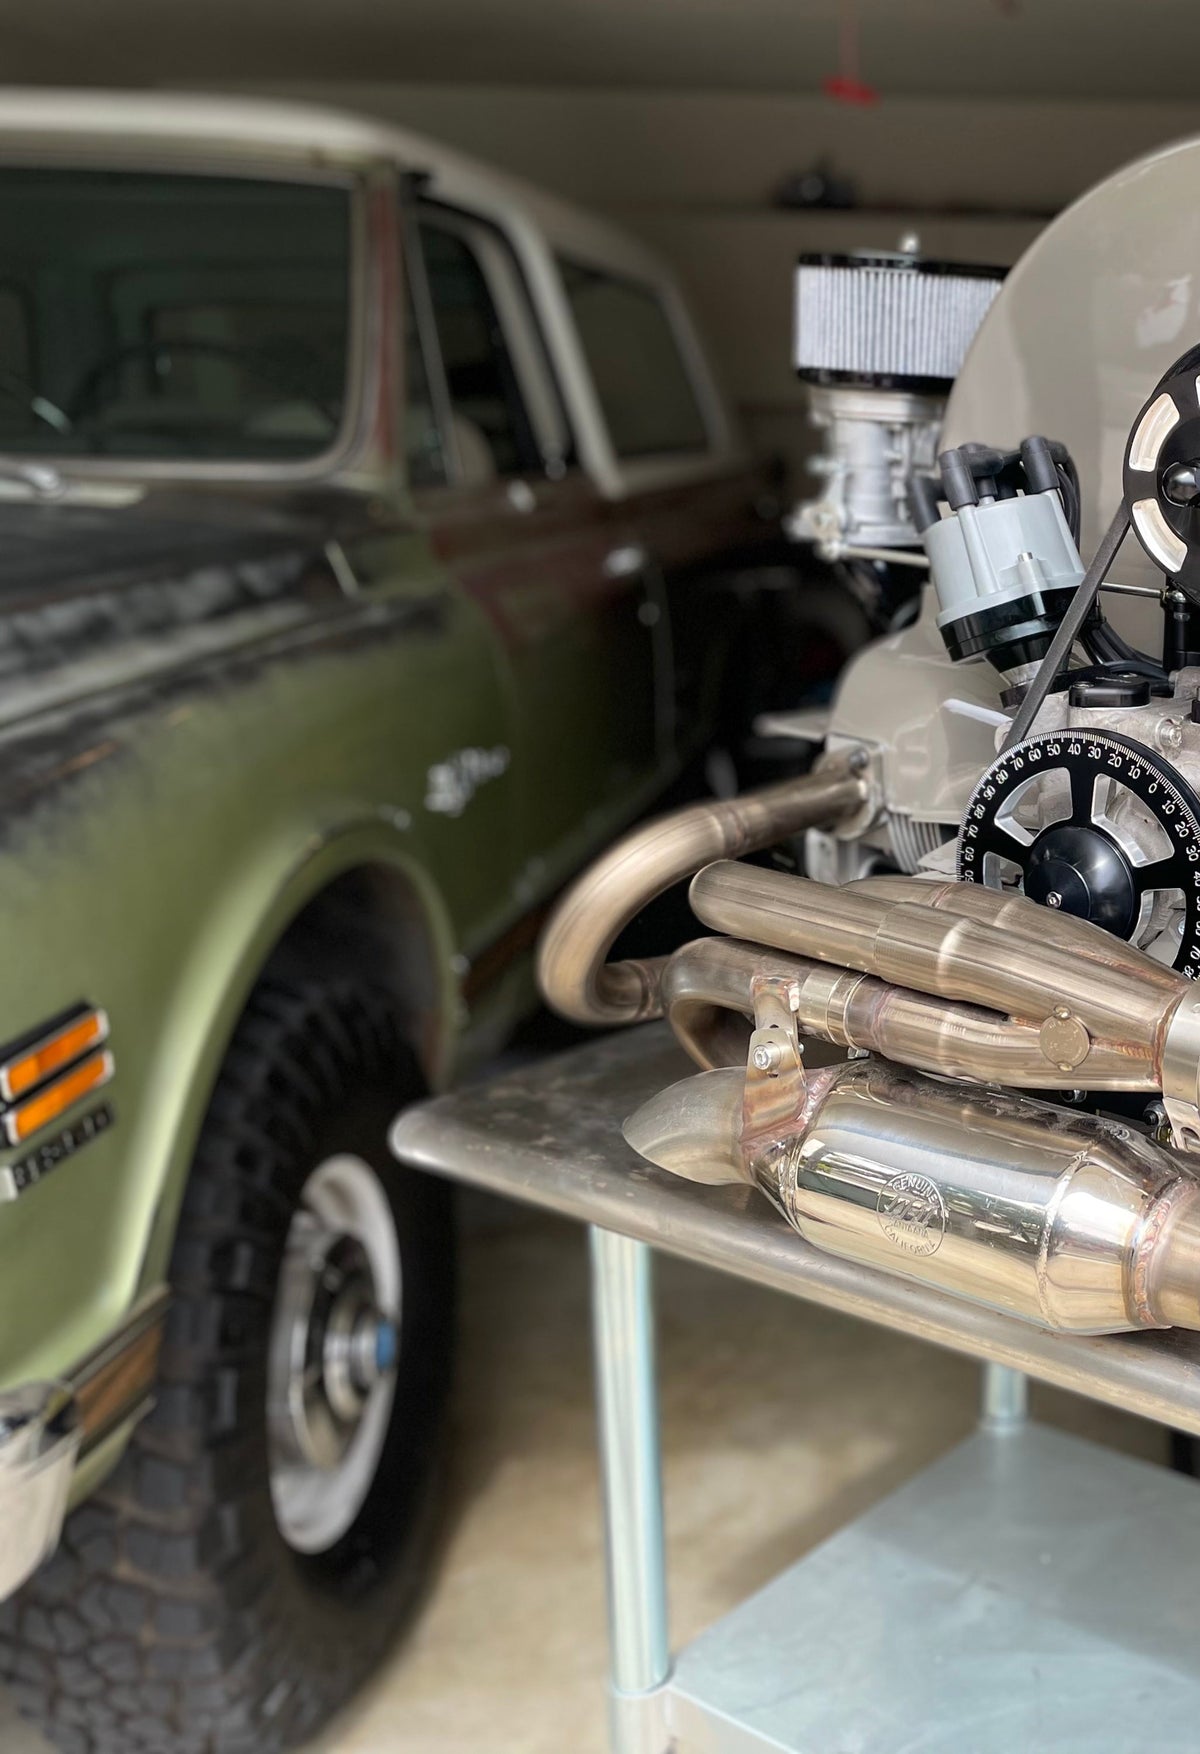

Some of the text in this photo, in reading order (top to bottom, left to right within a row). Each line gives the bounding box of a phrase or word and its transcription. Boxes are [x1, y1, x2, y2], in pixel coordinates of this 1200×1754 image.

[1028, 748, 1042, 762] 60
[1047, 743, 1061, 756] 50
[1067, 743, 1081, 755] 40
[1087, 746, 1101, 759] 30
[1010, 757, 1024, 771] 70
[1108, 753, 1122, 768] 20
[995, 769, 1009, 784] 80
[1128, 765, 1141, 779] 10
[983, 785, 996, 800] 90
[1148, 783, 1158, 794] 0
[974, 804, 986, 819] 80
[1162, 800, 1175, 814] 10
[967, 824, 979, 838] 70
[1175, 821, 1189, 838] 20
[965, 847, 975, 862] 60
[1186, 844, 1199, 861] 30
[892, 1175, 939, 1204] GENUINE
